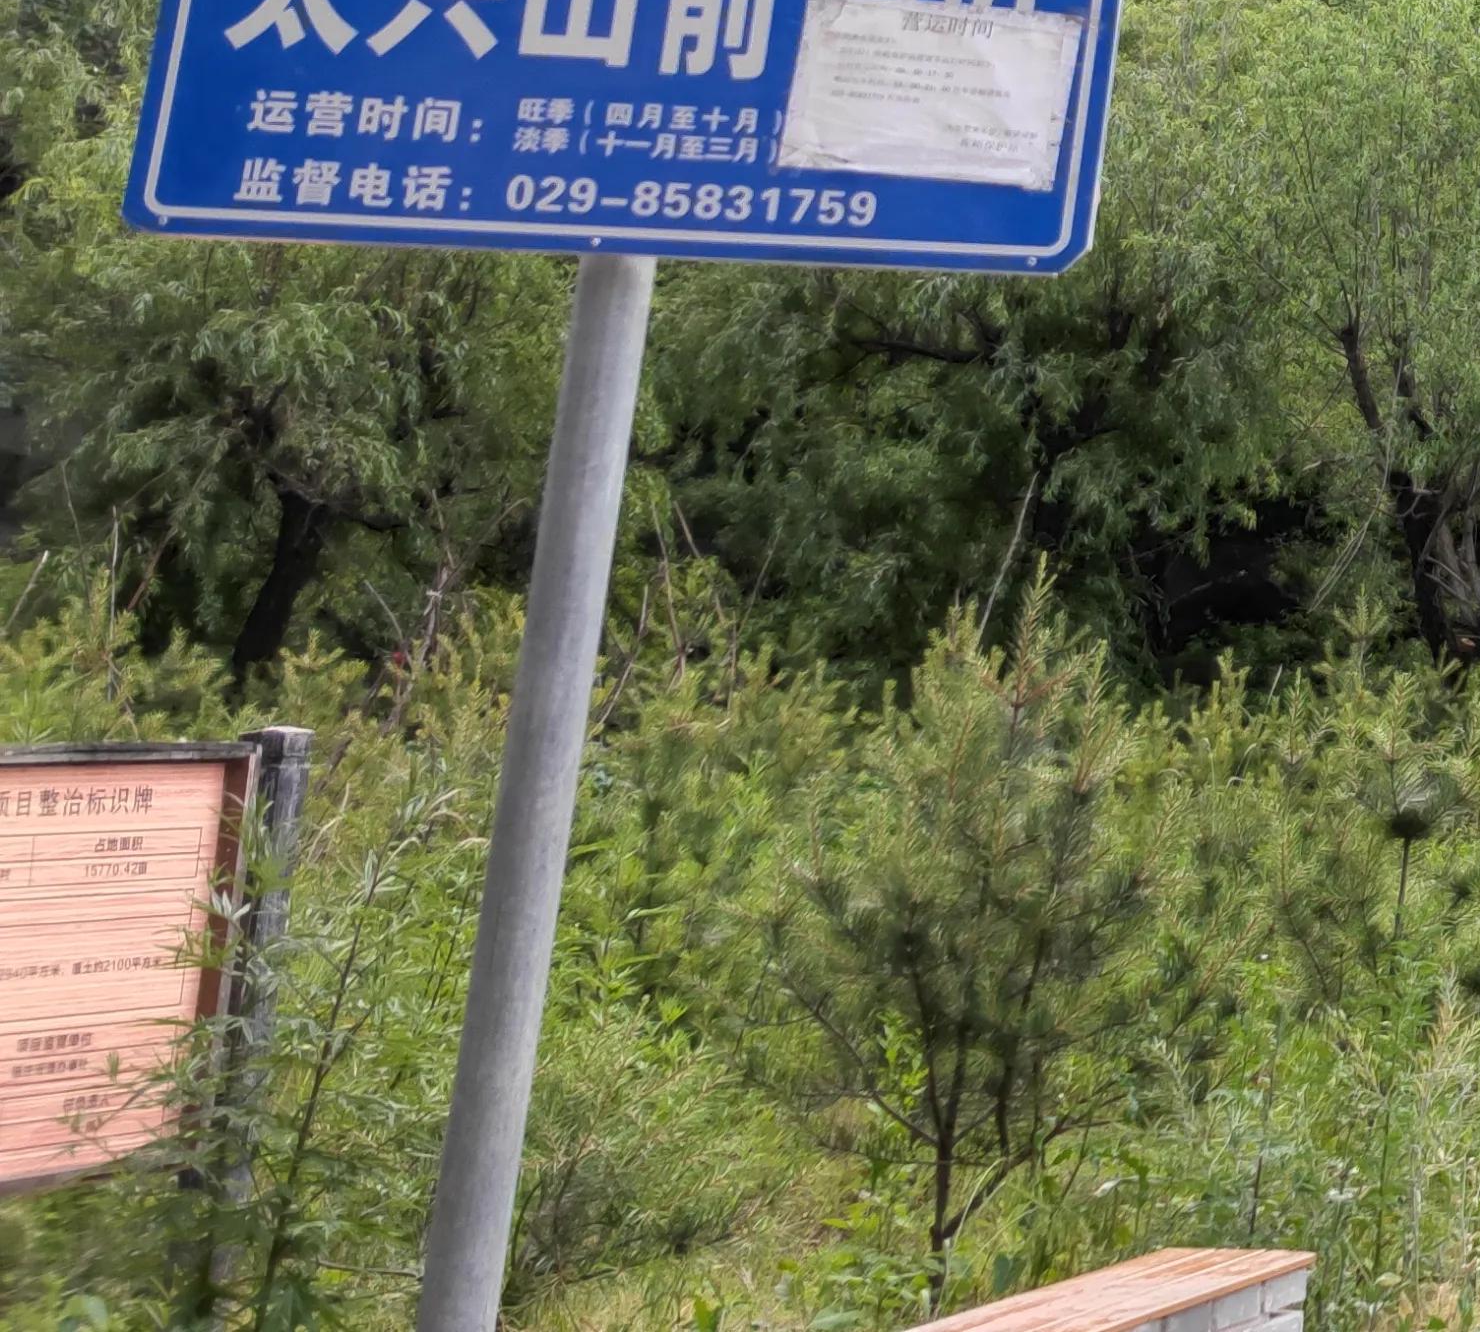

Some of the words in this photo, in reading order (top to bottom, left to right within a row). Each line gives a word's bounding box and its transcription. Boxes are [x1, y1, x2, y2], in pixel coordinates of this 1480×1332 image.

[902, 11, 994, 40] 营运时间
[247, 88, 483, 143] 运营时间：
